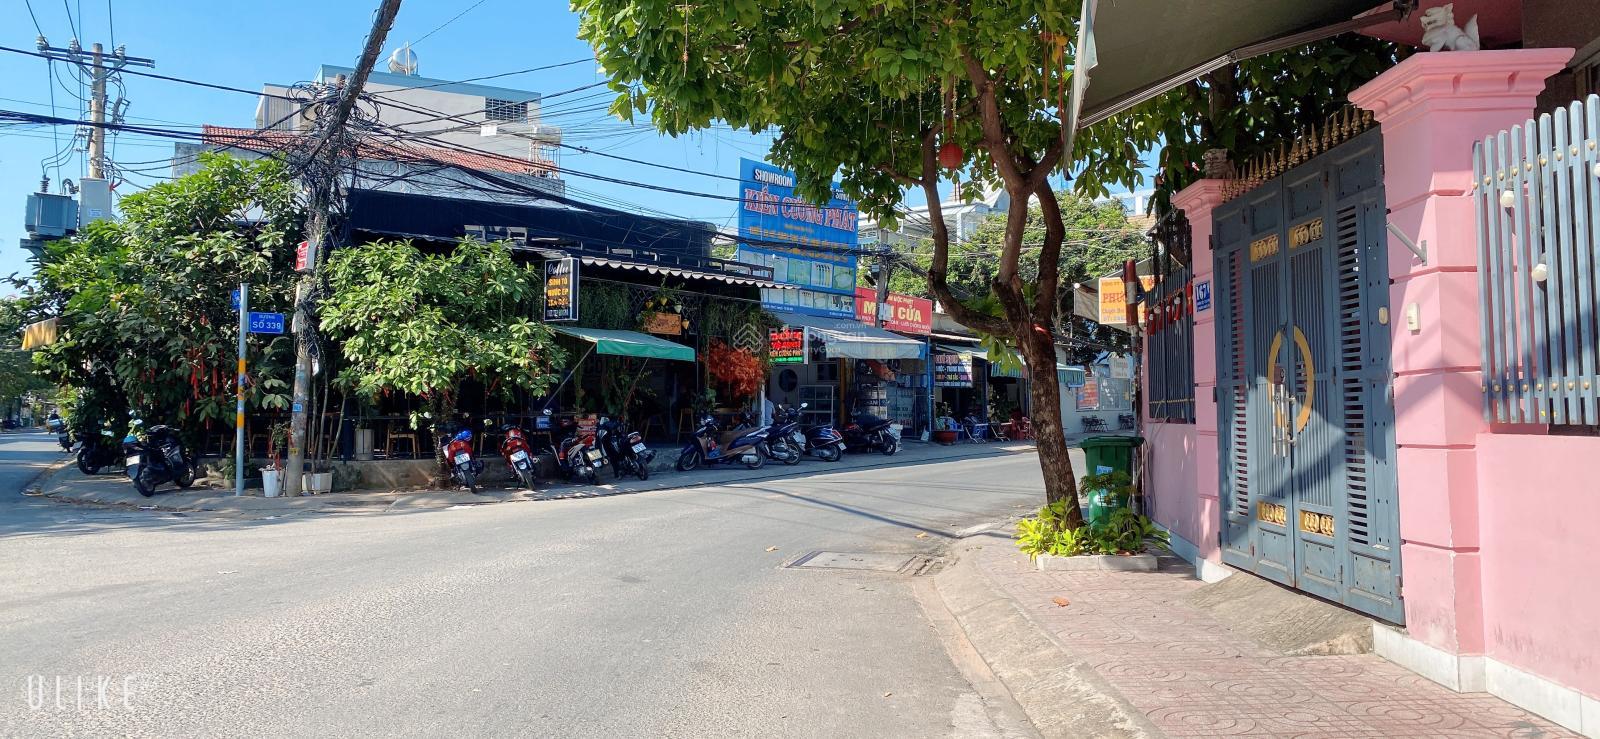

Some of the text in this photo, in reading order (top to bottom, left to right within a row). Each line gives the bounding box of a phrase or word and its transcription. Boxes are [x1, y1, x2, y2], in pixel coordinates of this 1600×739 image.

[754, 168, 793, 187] SHOWROOM
[824, 204, 858, 233] PHÁT
[548, 262, 568, 275] Coffee
[898, 305, 922, 323] CỬA
[252, 319, 265, 329] SỐ
